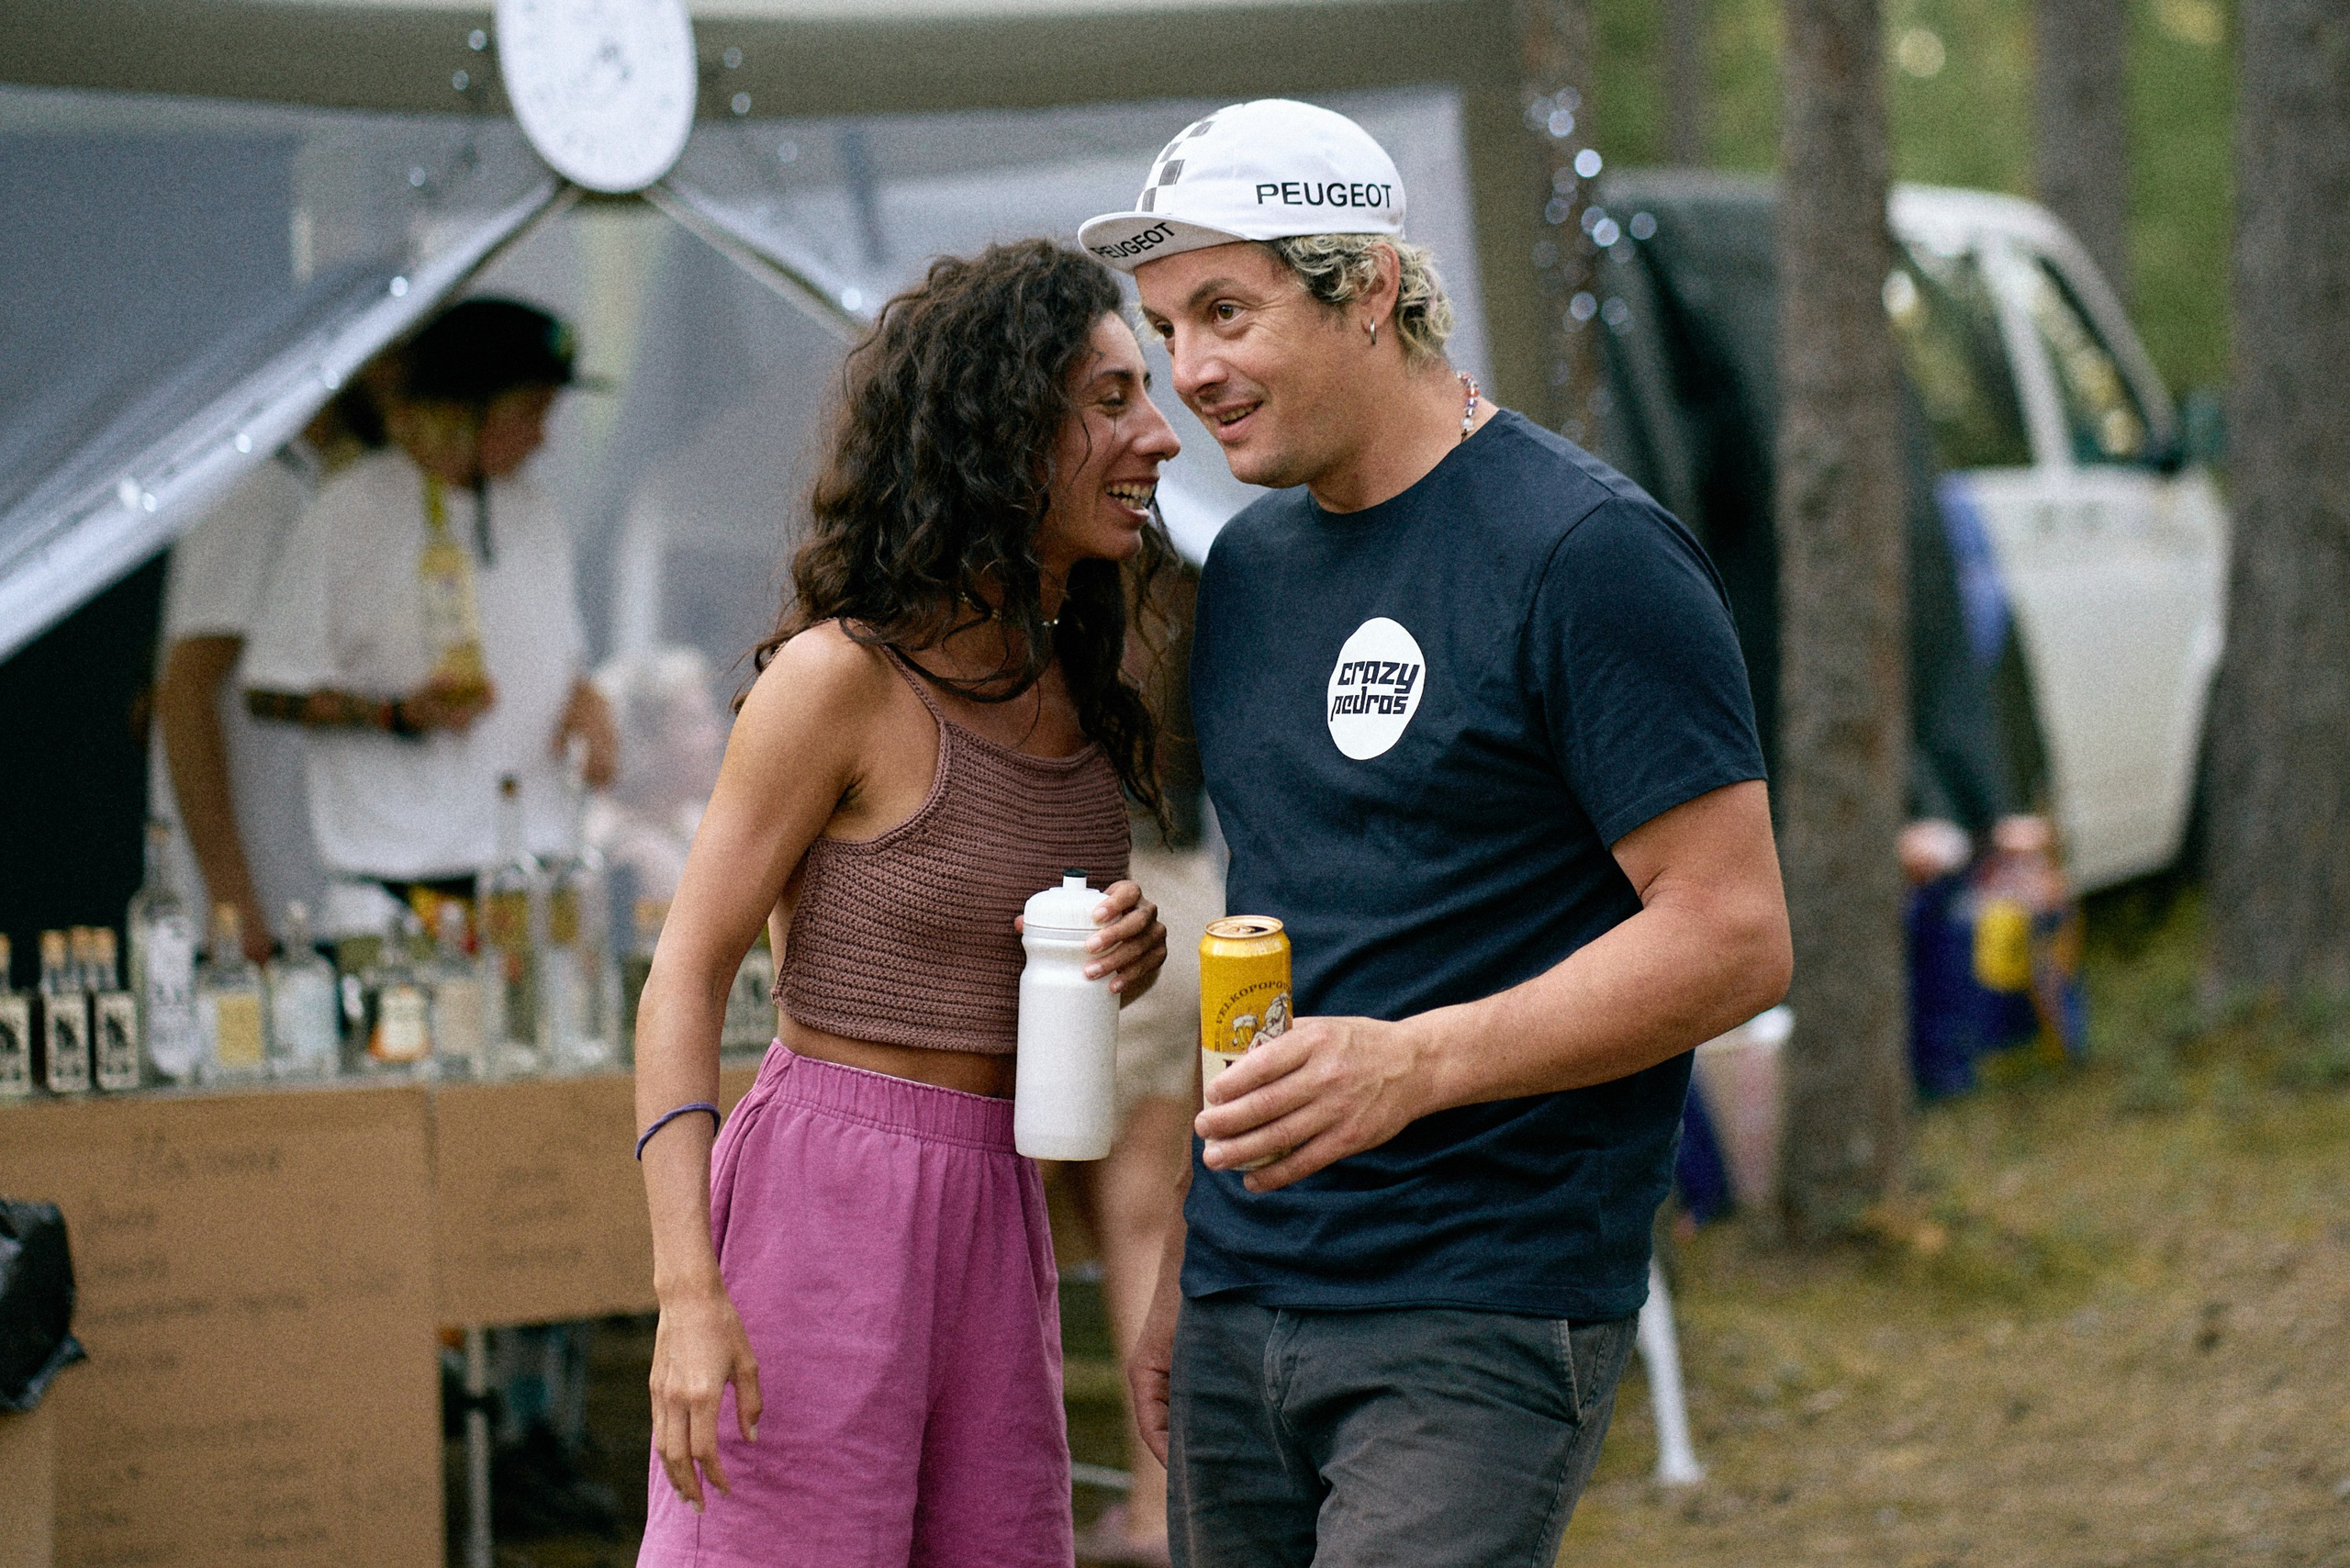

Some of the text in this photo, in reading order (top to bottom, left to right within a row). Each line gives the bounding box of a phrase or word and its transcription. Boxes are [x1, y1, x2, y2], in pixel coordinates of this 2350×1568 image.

[1256, 182, 1392, 207] PEUGEOT
[1337, 660, 1421, 694] crazy
[1330, 686, 1409, 722] pedros
